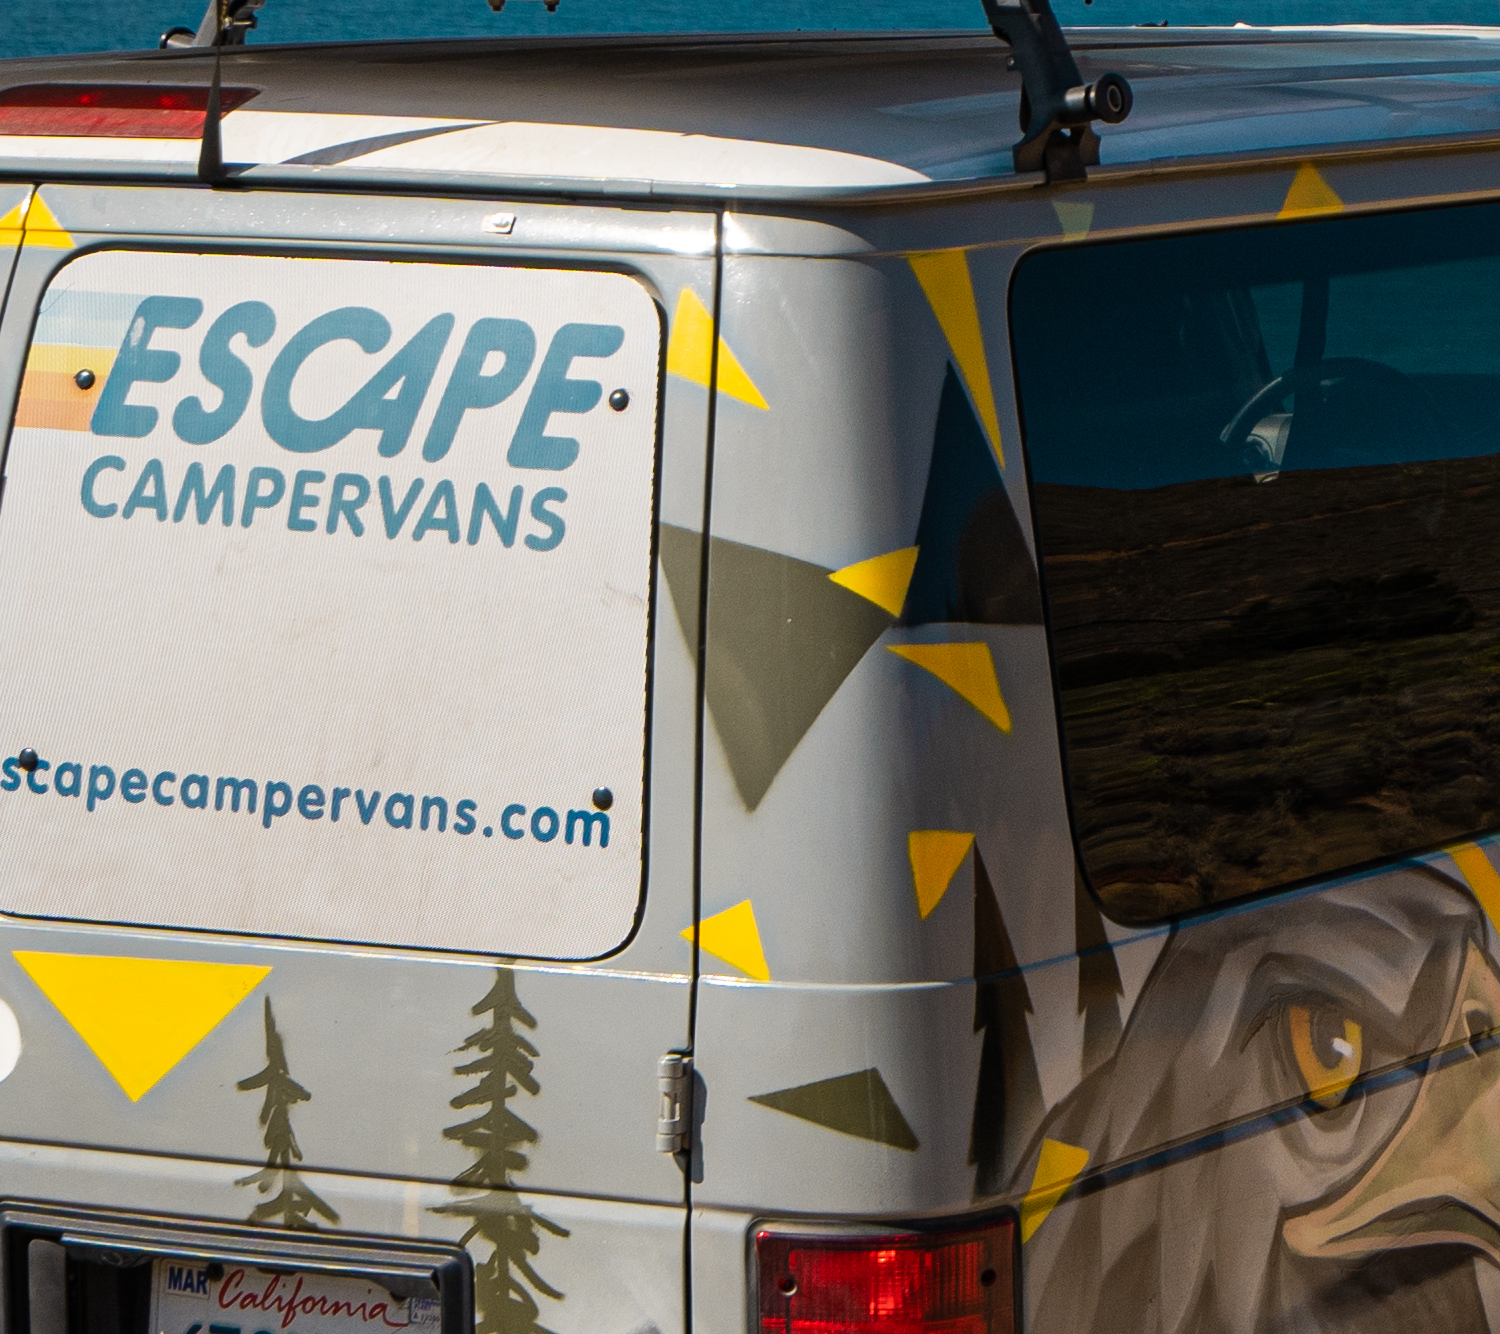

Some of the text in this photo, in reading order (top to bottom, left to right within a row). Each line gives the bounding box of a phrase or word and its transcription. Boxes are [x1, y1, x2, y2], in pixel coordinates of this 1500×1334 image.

[89, 295, 625, 471] ESCAPE
[80, 455, 568, 552] CAMPERVANS
[168, 1266, 209, 1295] MAR
[217, 1268, 411, 1328] California
